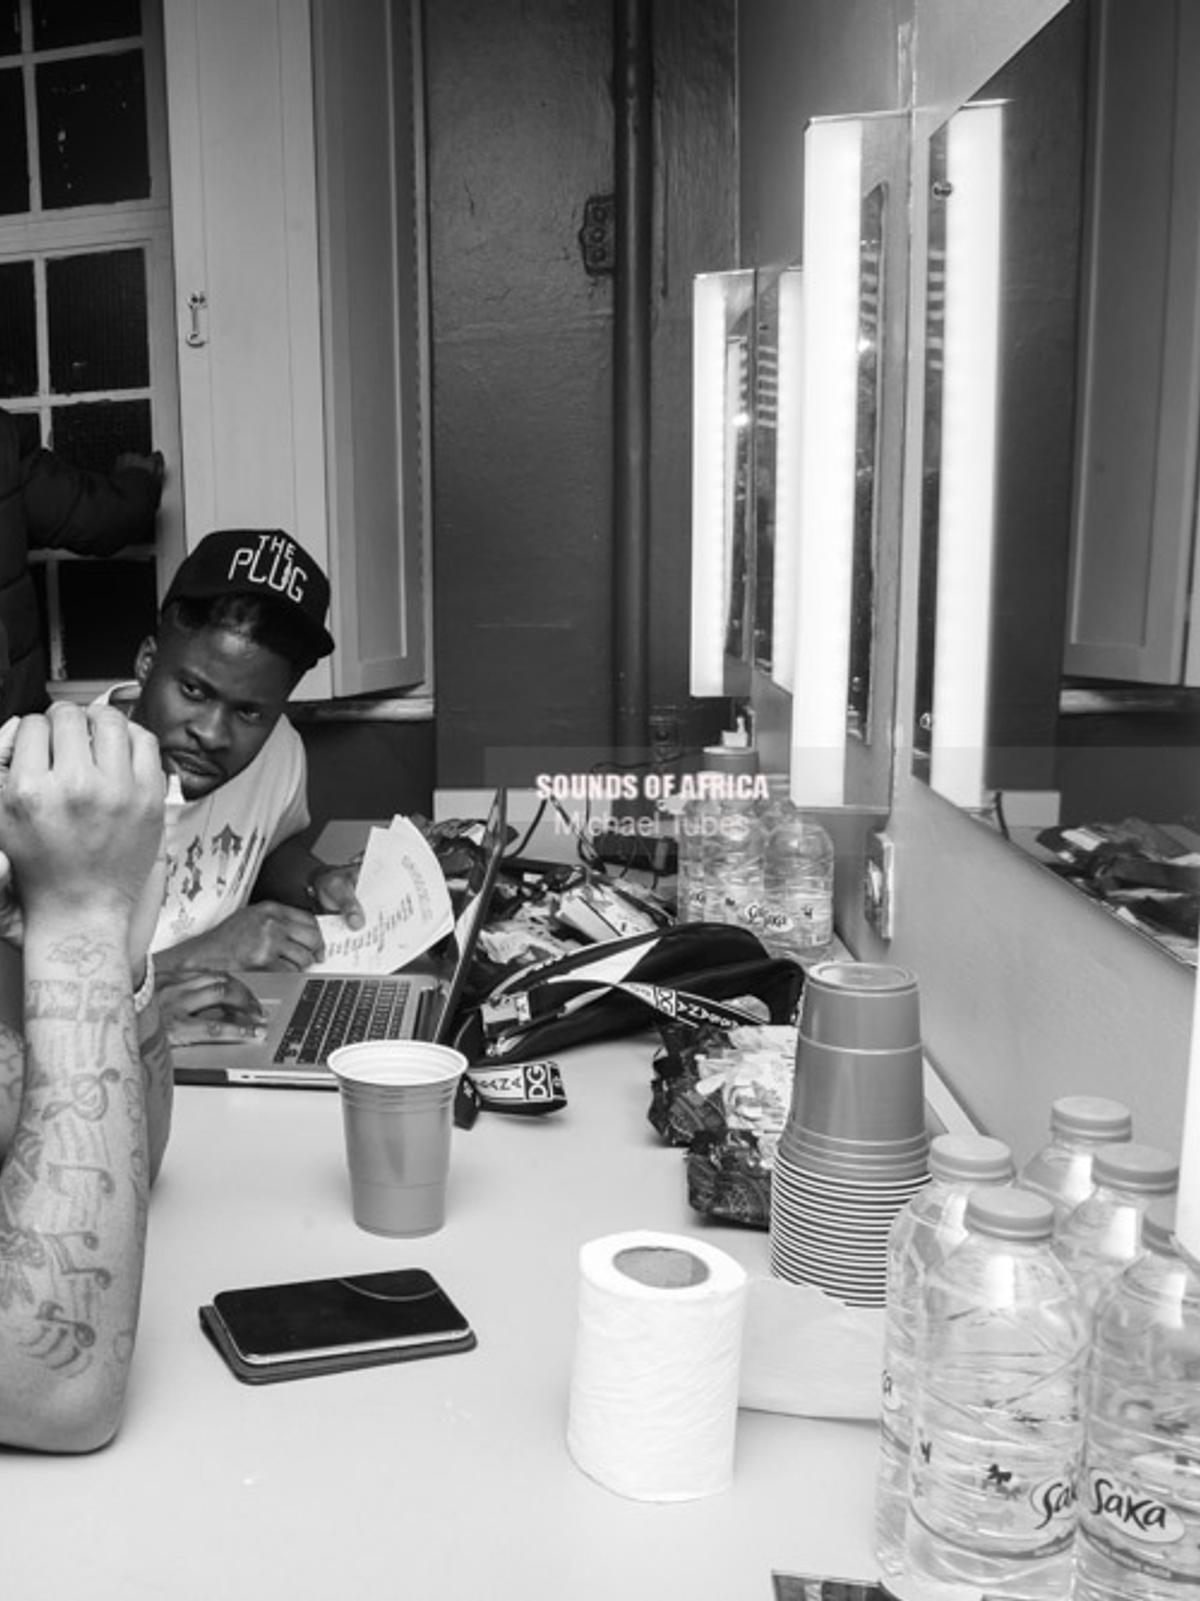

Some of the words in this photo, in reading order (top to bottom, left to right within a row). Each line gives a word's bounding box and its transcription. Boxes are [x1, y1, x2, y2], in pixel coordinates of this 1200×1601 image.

[258, 534, 297, 559] THE
[227, 547, 308, 603] PLUG
[525, 1065, 548, 1098] DG
